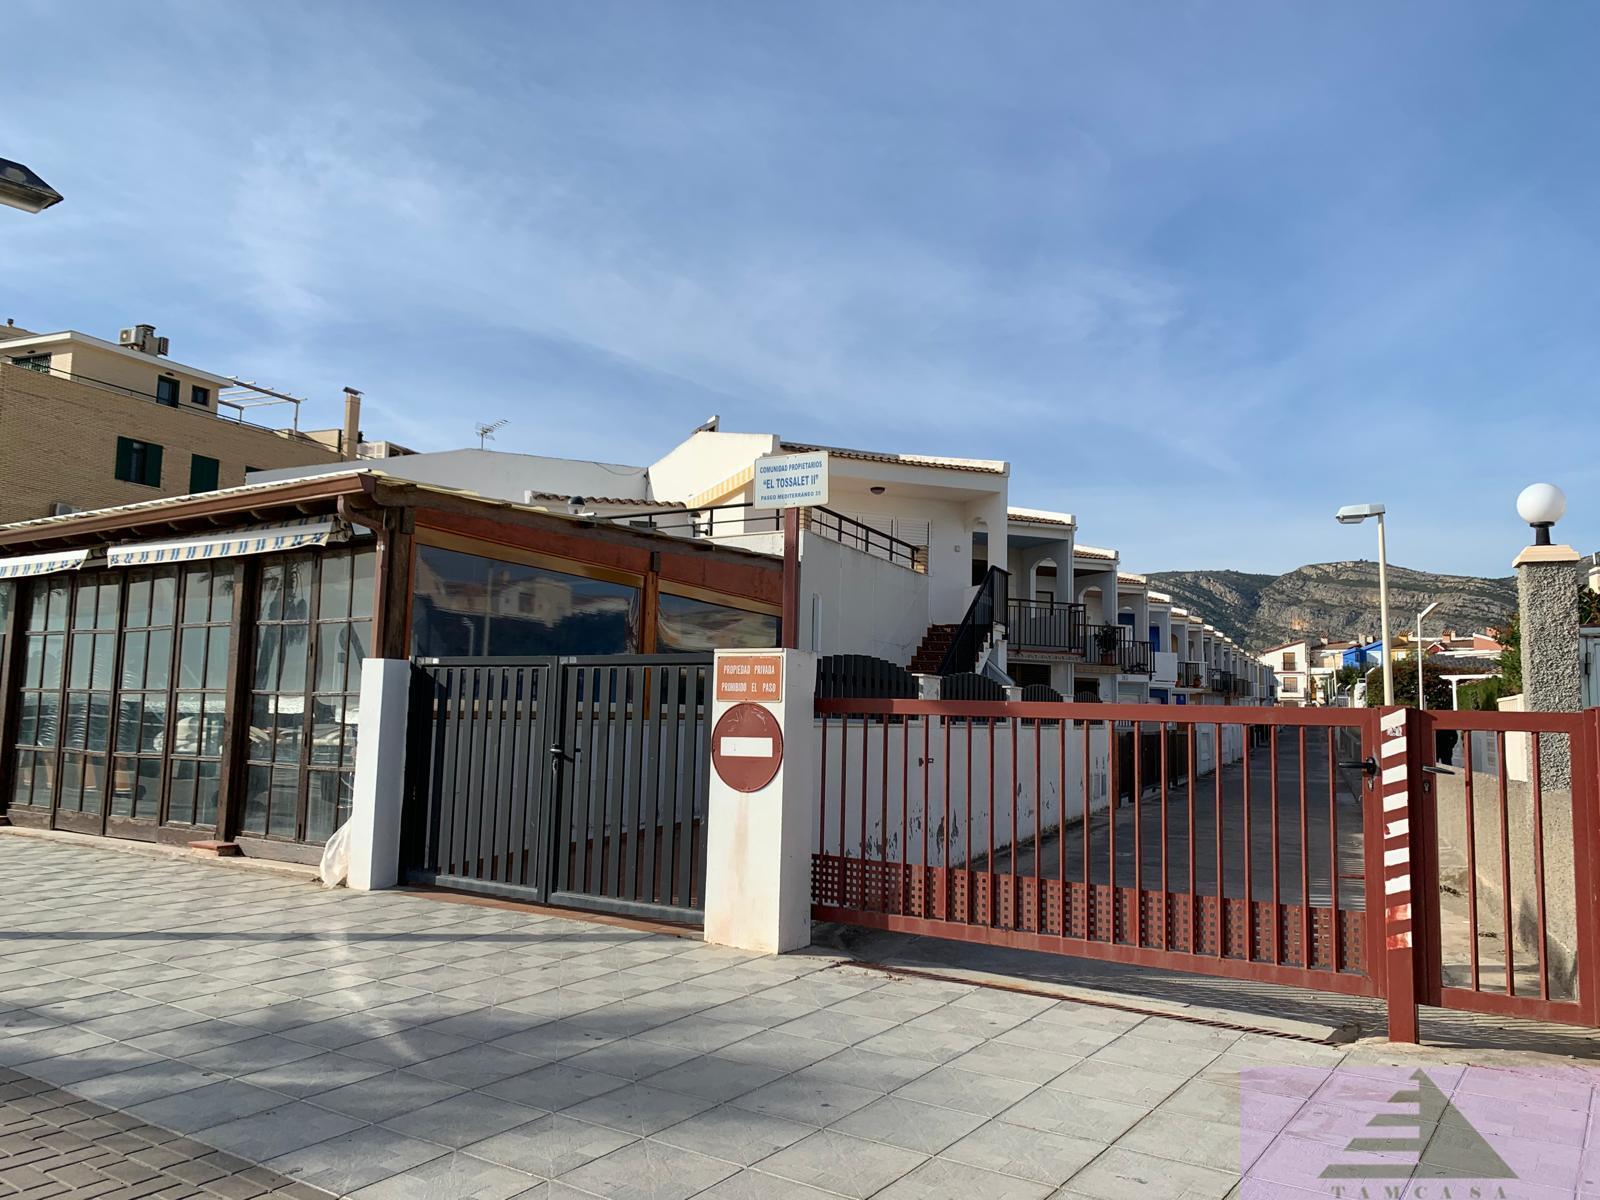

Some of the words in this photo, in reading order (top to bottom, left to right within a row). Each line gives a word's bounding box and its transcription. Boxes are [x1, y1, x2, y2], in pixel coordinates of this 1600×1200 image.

[760, 464, 788, 474] COMUNIDAD
[789, 461, 822, 471] PROPIETARIOS
[776, 475, 809, 488] TOSSALET
[723, 664, 750, 675] PROPIEDAD
[754, 664, 775, 675] PRIVADA
[721, 682, 747, 692] PROHIBIDO
[751, 682, 757, 692] EL
[762, 682, 776, 693] PASO
